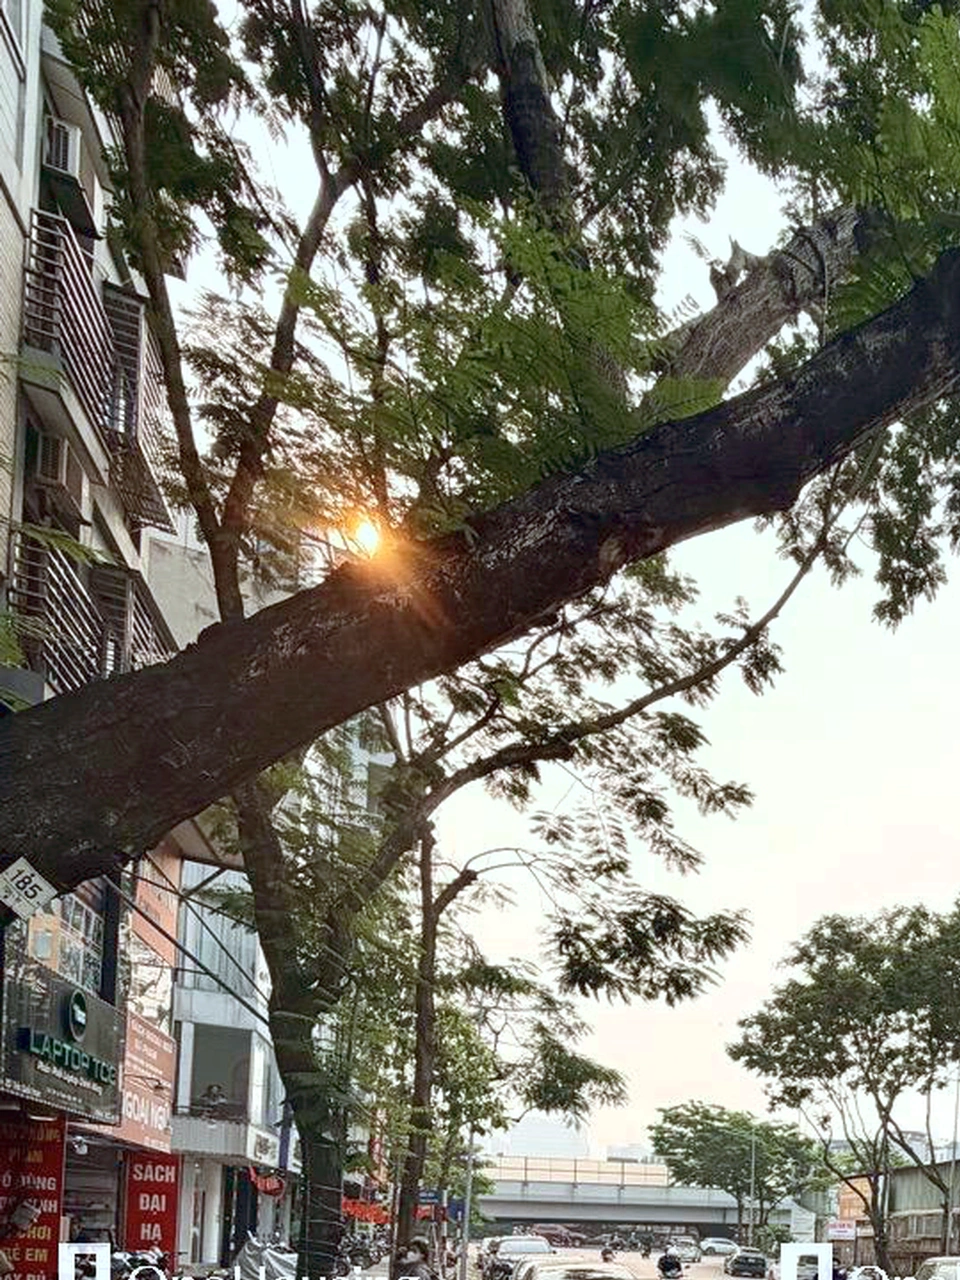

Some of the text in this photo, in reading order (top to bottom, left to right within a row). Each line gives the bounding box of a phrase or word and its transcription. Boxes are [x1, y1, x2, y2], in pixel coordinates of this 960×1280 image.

[10, 869, 43, 899] 185
[30, 1030, 90, 1070] LAPTOP
[133, 1162, 175, 1183] SÁCH
[140, 1193, 166, 1215] ĐẠI
[26, 1247, 49, 1262] EM
